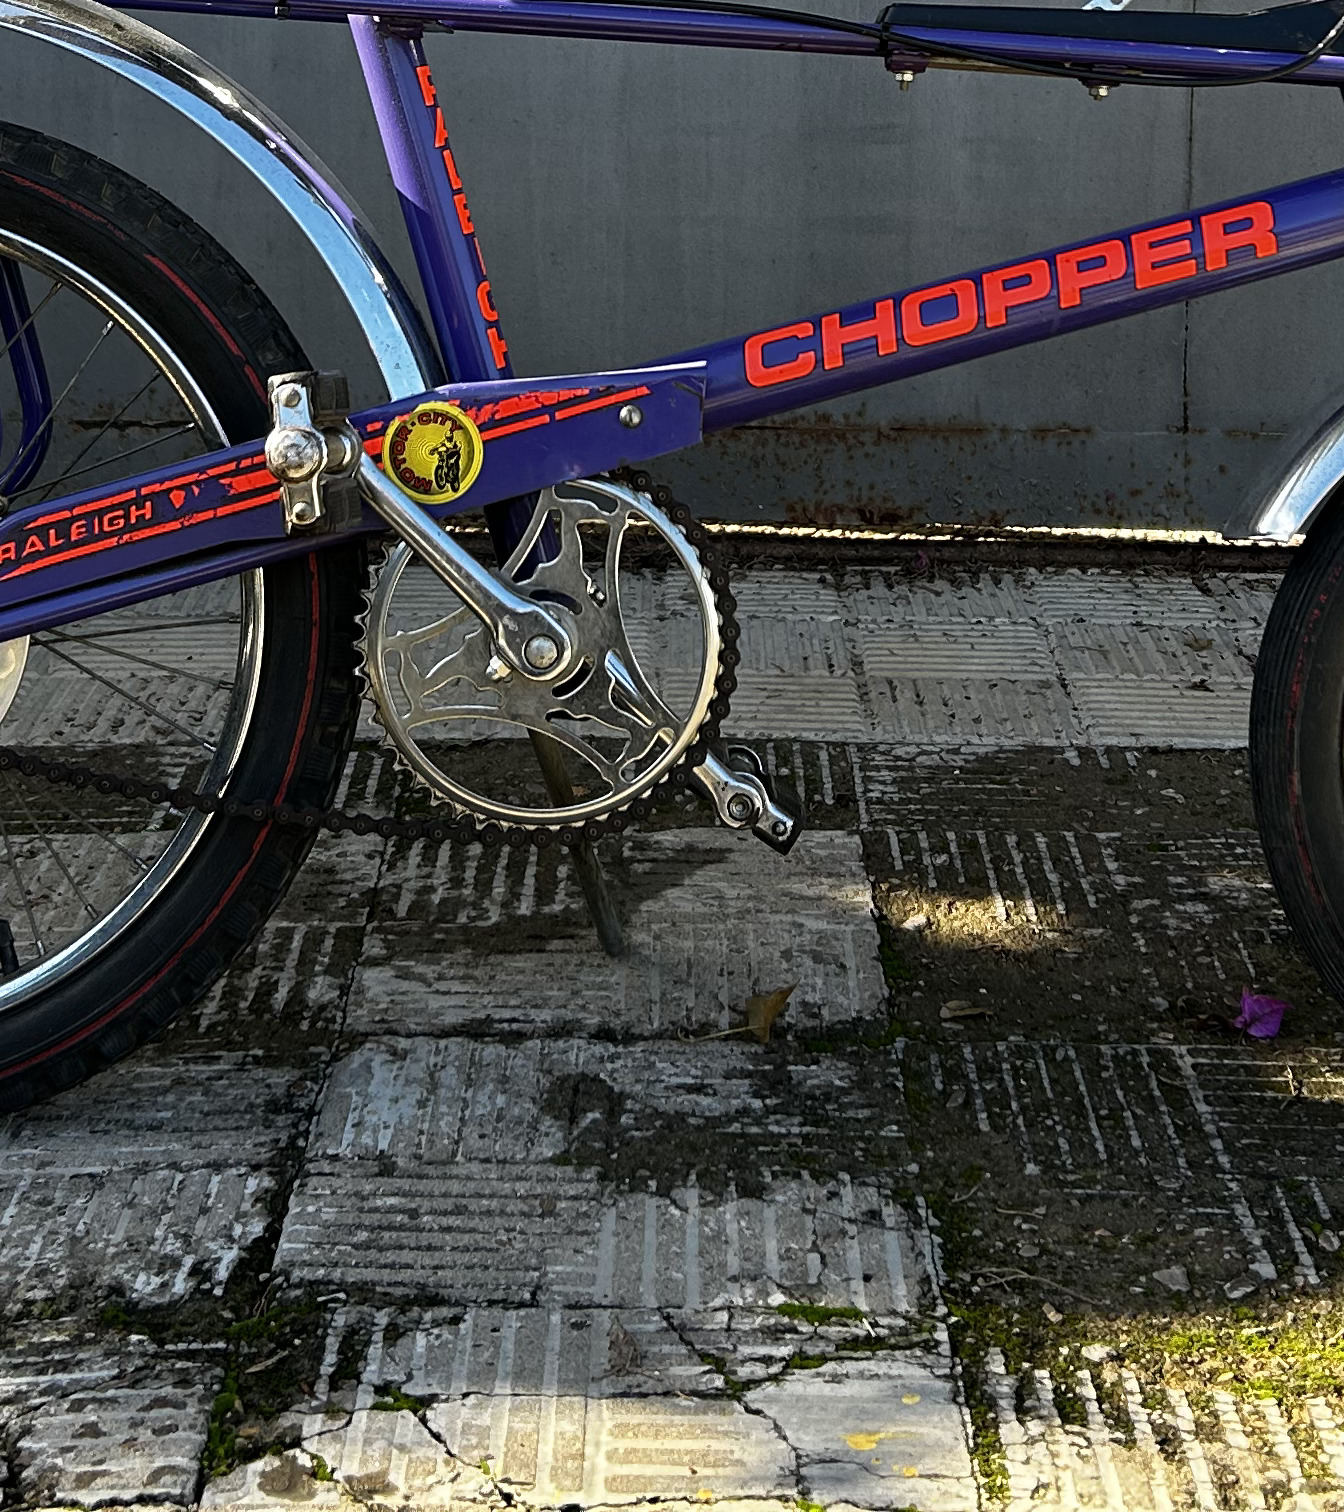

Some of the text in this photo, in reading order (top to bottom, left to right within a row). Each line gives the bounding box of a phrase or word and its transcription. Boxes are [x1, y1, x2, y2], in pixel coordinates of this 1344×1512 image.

[743, 201, 1279, 388] CHOPPER
[393, 412, 464, 492] MOTOR CITY
